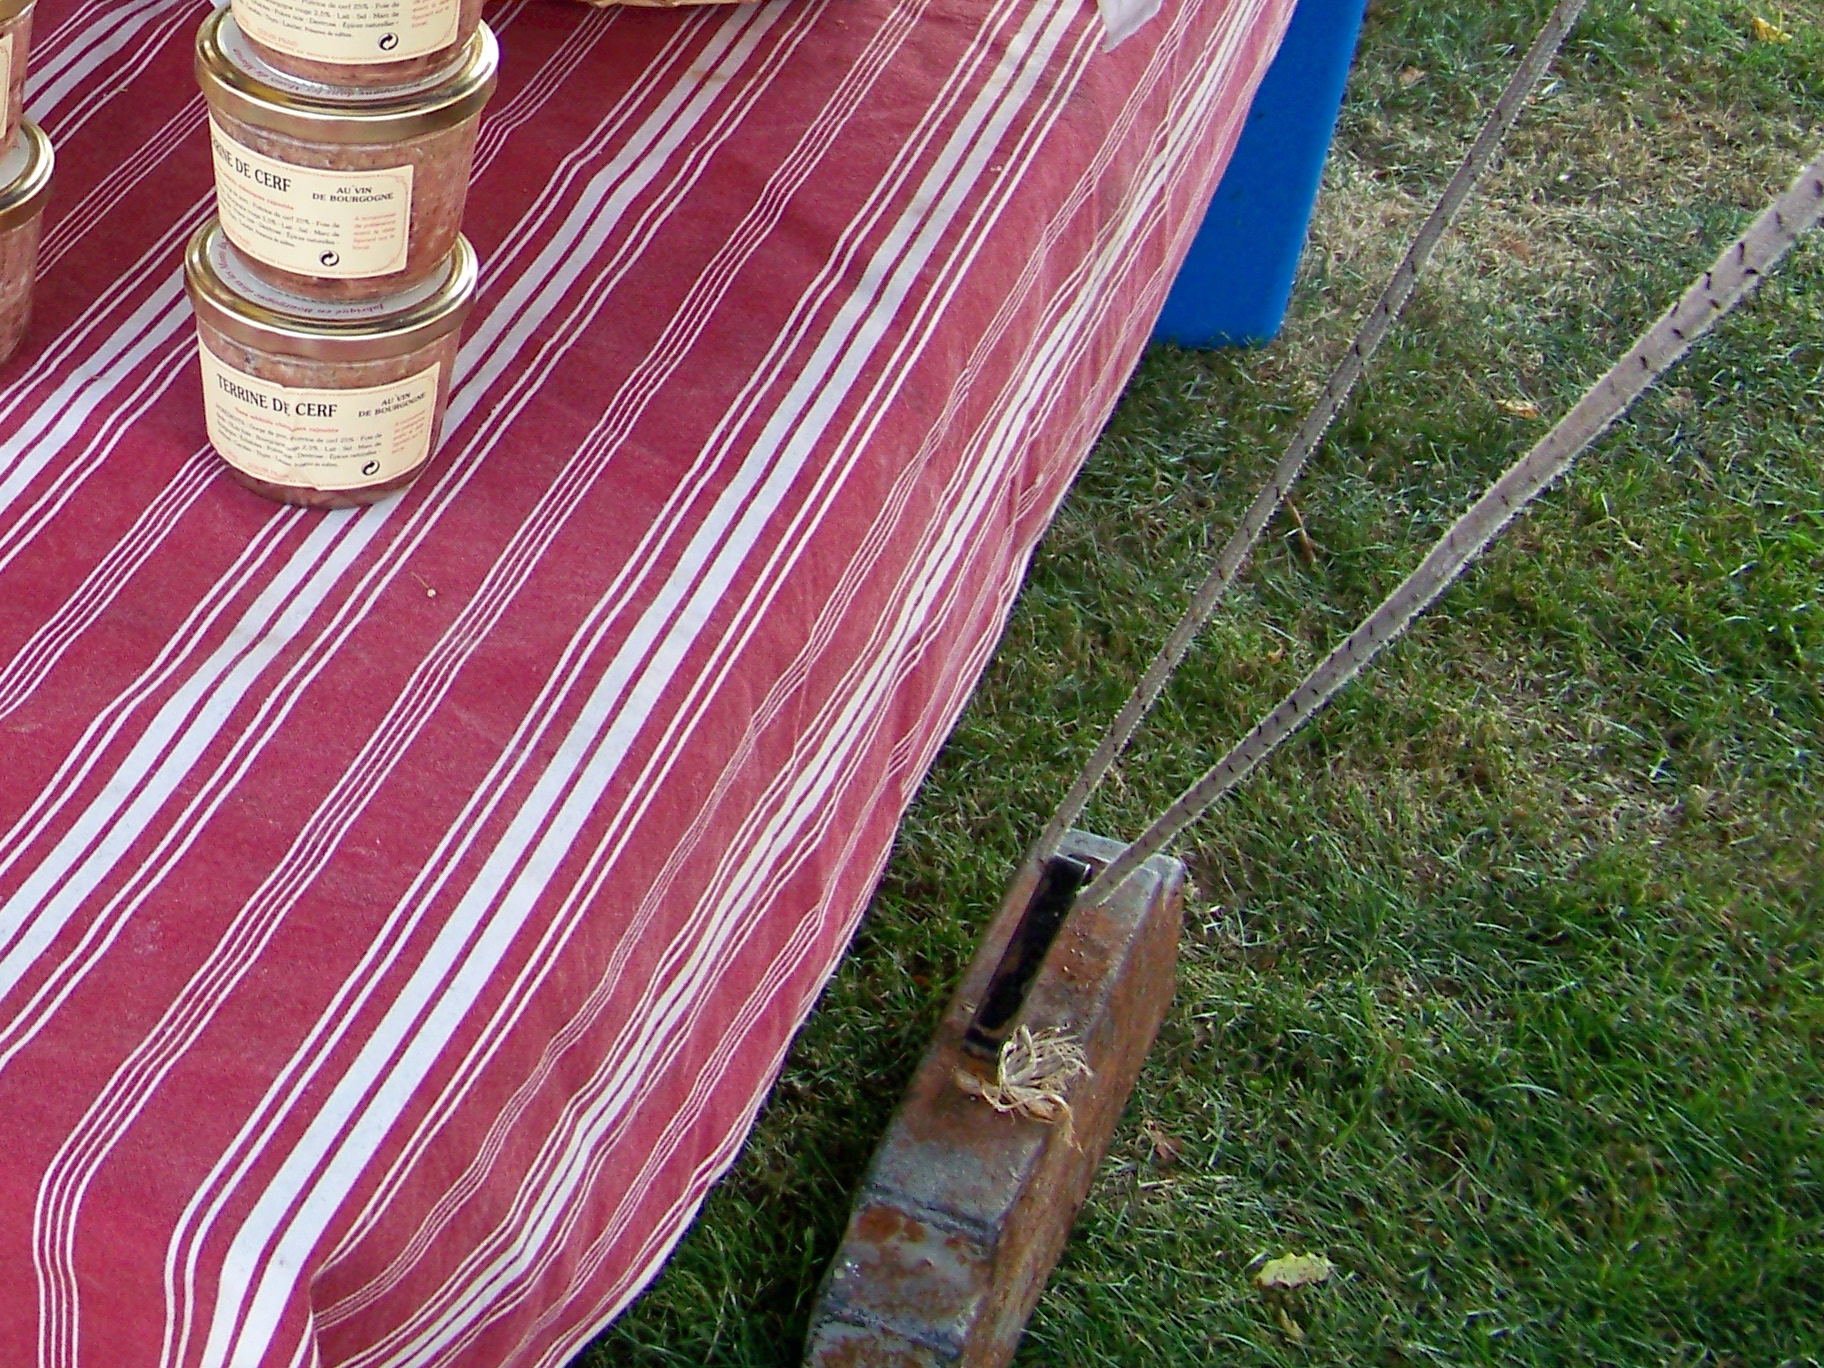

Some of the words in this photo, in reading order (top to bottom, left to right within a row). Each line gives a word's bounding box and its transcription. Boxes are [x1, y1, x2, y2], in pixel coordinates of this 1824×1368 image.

[235, 157, 252, 179] DE
[254, 168, 292, 193] CERF
[312, 192, 326, 201] DE
[329, 192, 394, 203] BOURGOGNE
[354, 186, 372, 194] VIN
[216, 373, 269, 410] TERRINE
[272, 397, 291, 417] DE
[295, 403, 338, 418] CERF
[374, 392, 427, 415] BOURGOGNE
